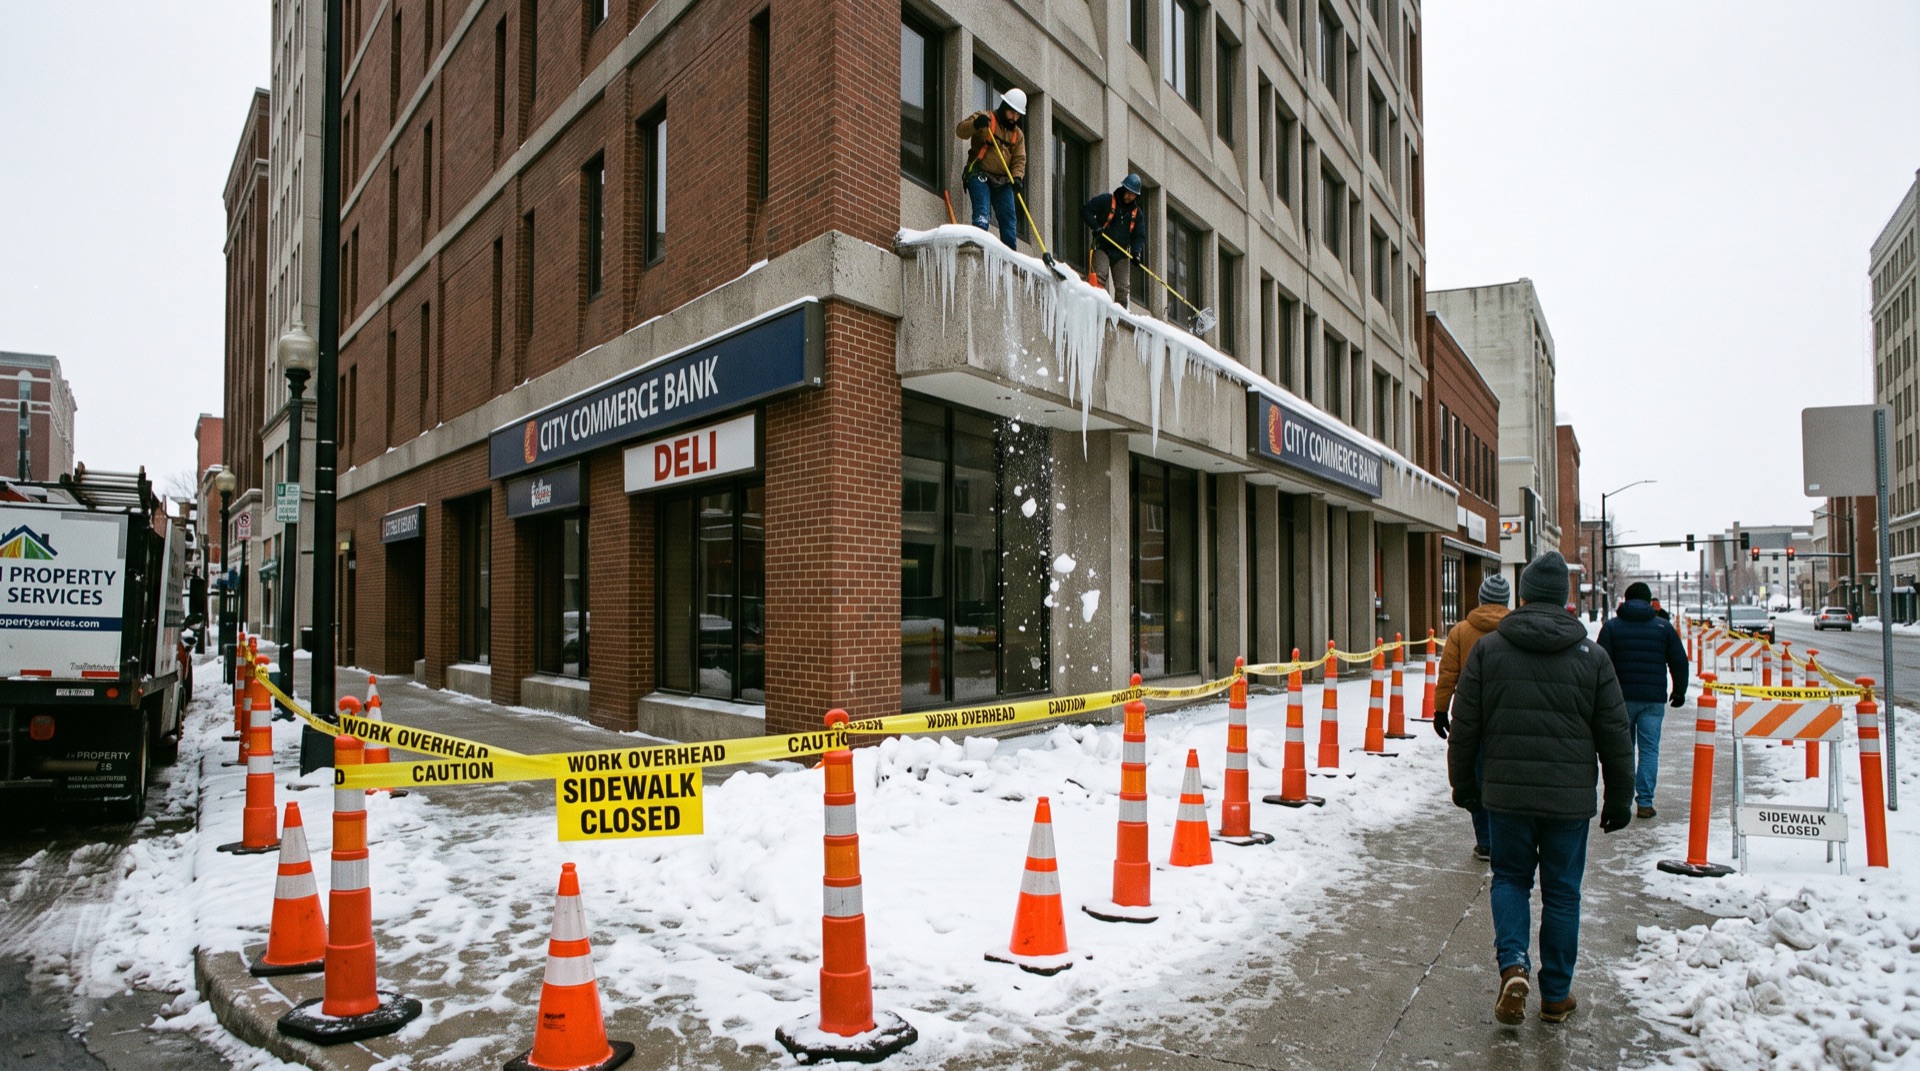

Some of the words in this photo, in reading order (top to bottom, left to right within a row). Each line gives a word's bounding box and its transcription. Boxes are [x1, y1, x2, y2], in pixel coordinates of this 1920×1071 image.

[540, 413, 568, 452] CITY
[571, 378, 659, 441] COMMERCE
[664, 355, 719, 411] BANK
[654, 430, 717, 482] DELI
[1284, 420, 1308, 457] CITY
[1309, 431, 1358, 478] COMMERCE
[1359, 454, 1378, 487] BANK
[9, 566, 117, 586] PROPERTY
[7, 587, 103, 606] SERVICES
[961, 706, 1016, 726] OVERHEAD
[1048, 697, 1086, 715] CAUTION
[343, 717, 393, 743] WORK
[76, 751, 131, 760] PROPERTY
[567, 752, 623, 773] WORK
[628, 744, 726, 768] OVERHEAD
[412, 761, 494, 782] CAUTION
[563, 772, 696, 804] SIDEWALK
[580, 805, 681, 835] CLOSED
[1759, 811, 1826, 825] SIDEWALK
[1772, 824, 1820, 836] CLOSED
